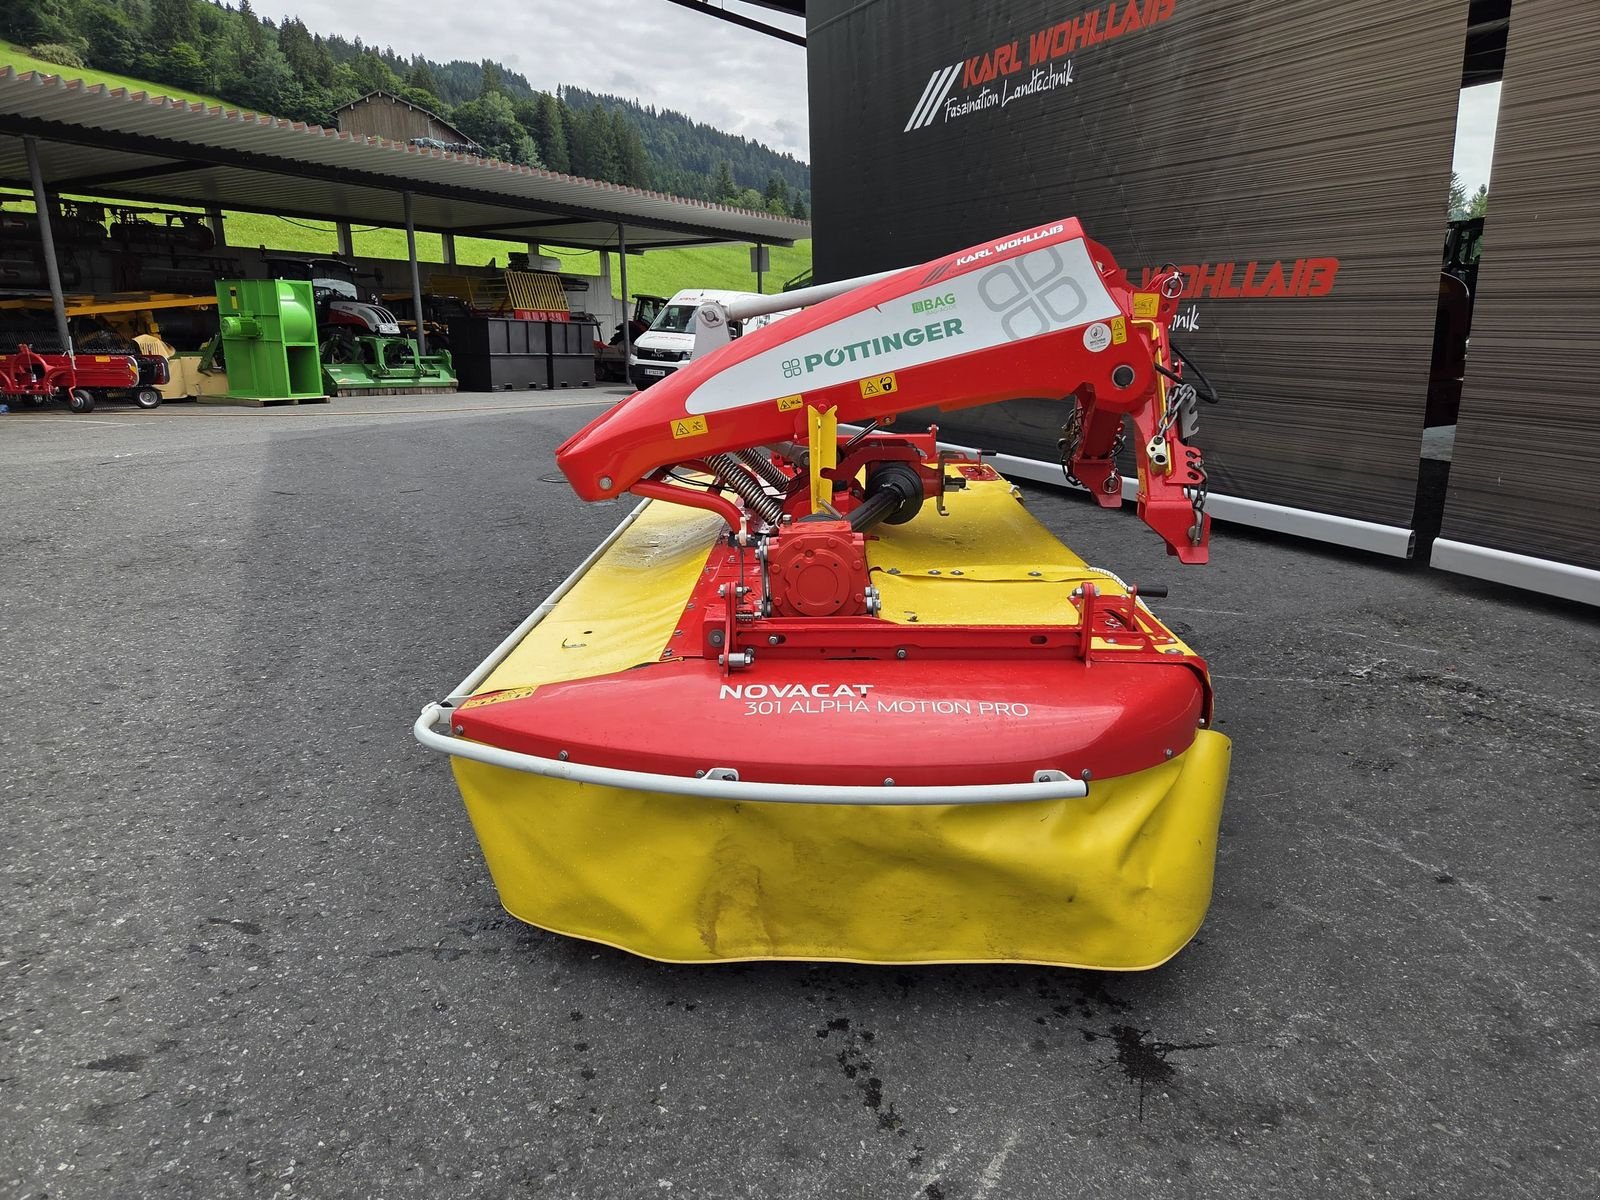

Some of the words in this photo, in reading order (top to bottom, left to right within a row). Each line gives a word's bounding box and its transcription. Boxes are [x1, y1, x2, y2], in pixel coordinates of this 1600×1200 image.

[963, 41, 1022, 89] KARL
[944, 86, 999, 123] Faszination
[1001, 59, 1074, 108] Landtechnik
[956, 249, 993, 266] KARL
[924, 293, 956, 311] BAG
[805, 318, 964, 373] PÖTTINGER
[719, 684, 874, 699] NOVACAT
[744, 701, 781, 715] 301
[789, 700, 870, 714] ALPHA
[878, 700, 971, 715] MOTION
[979, 702, 1029, 717] PRO
